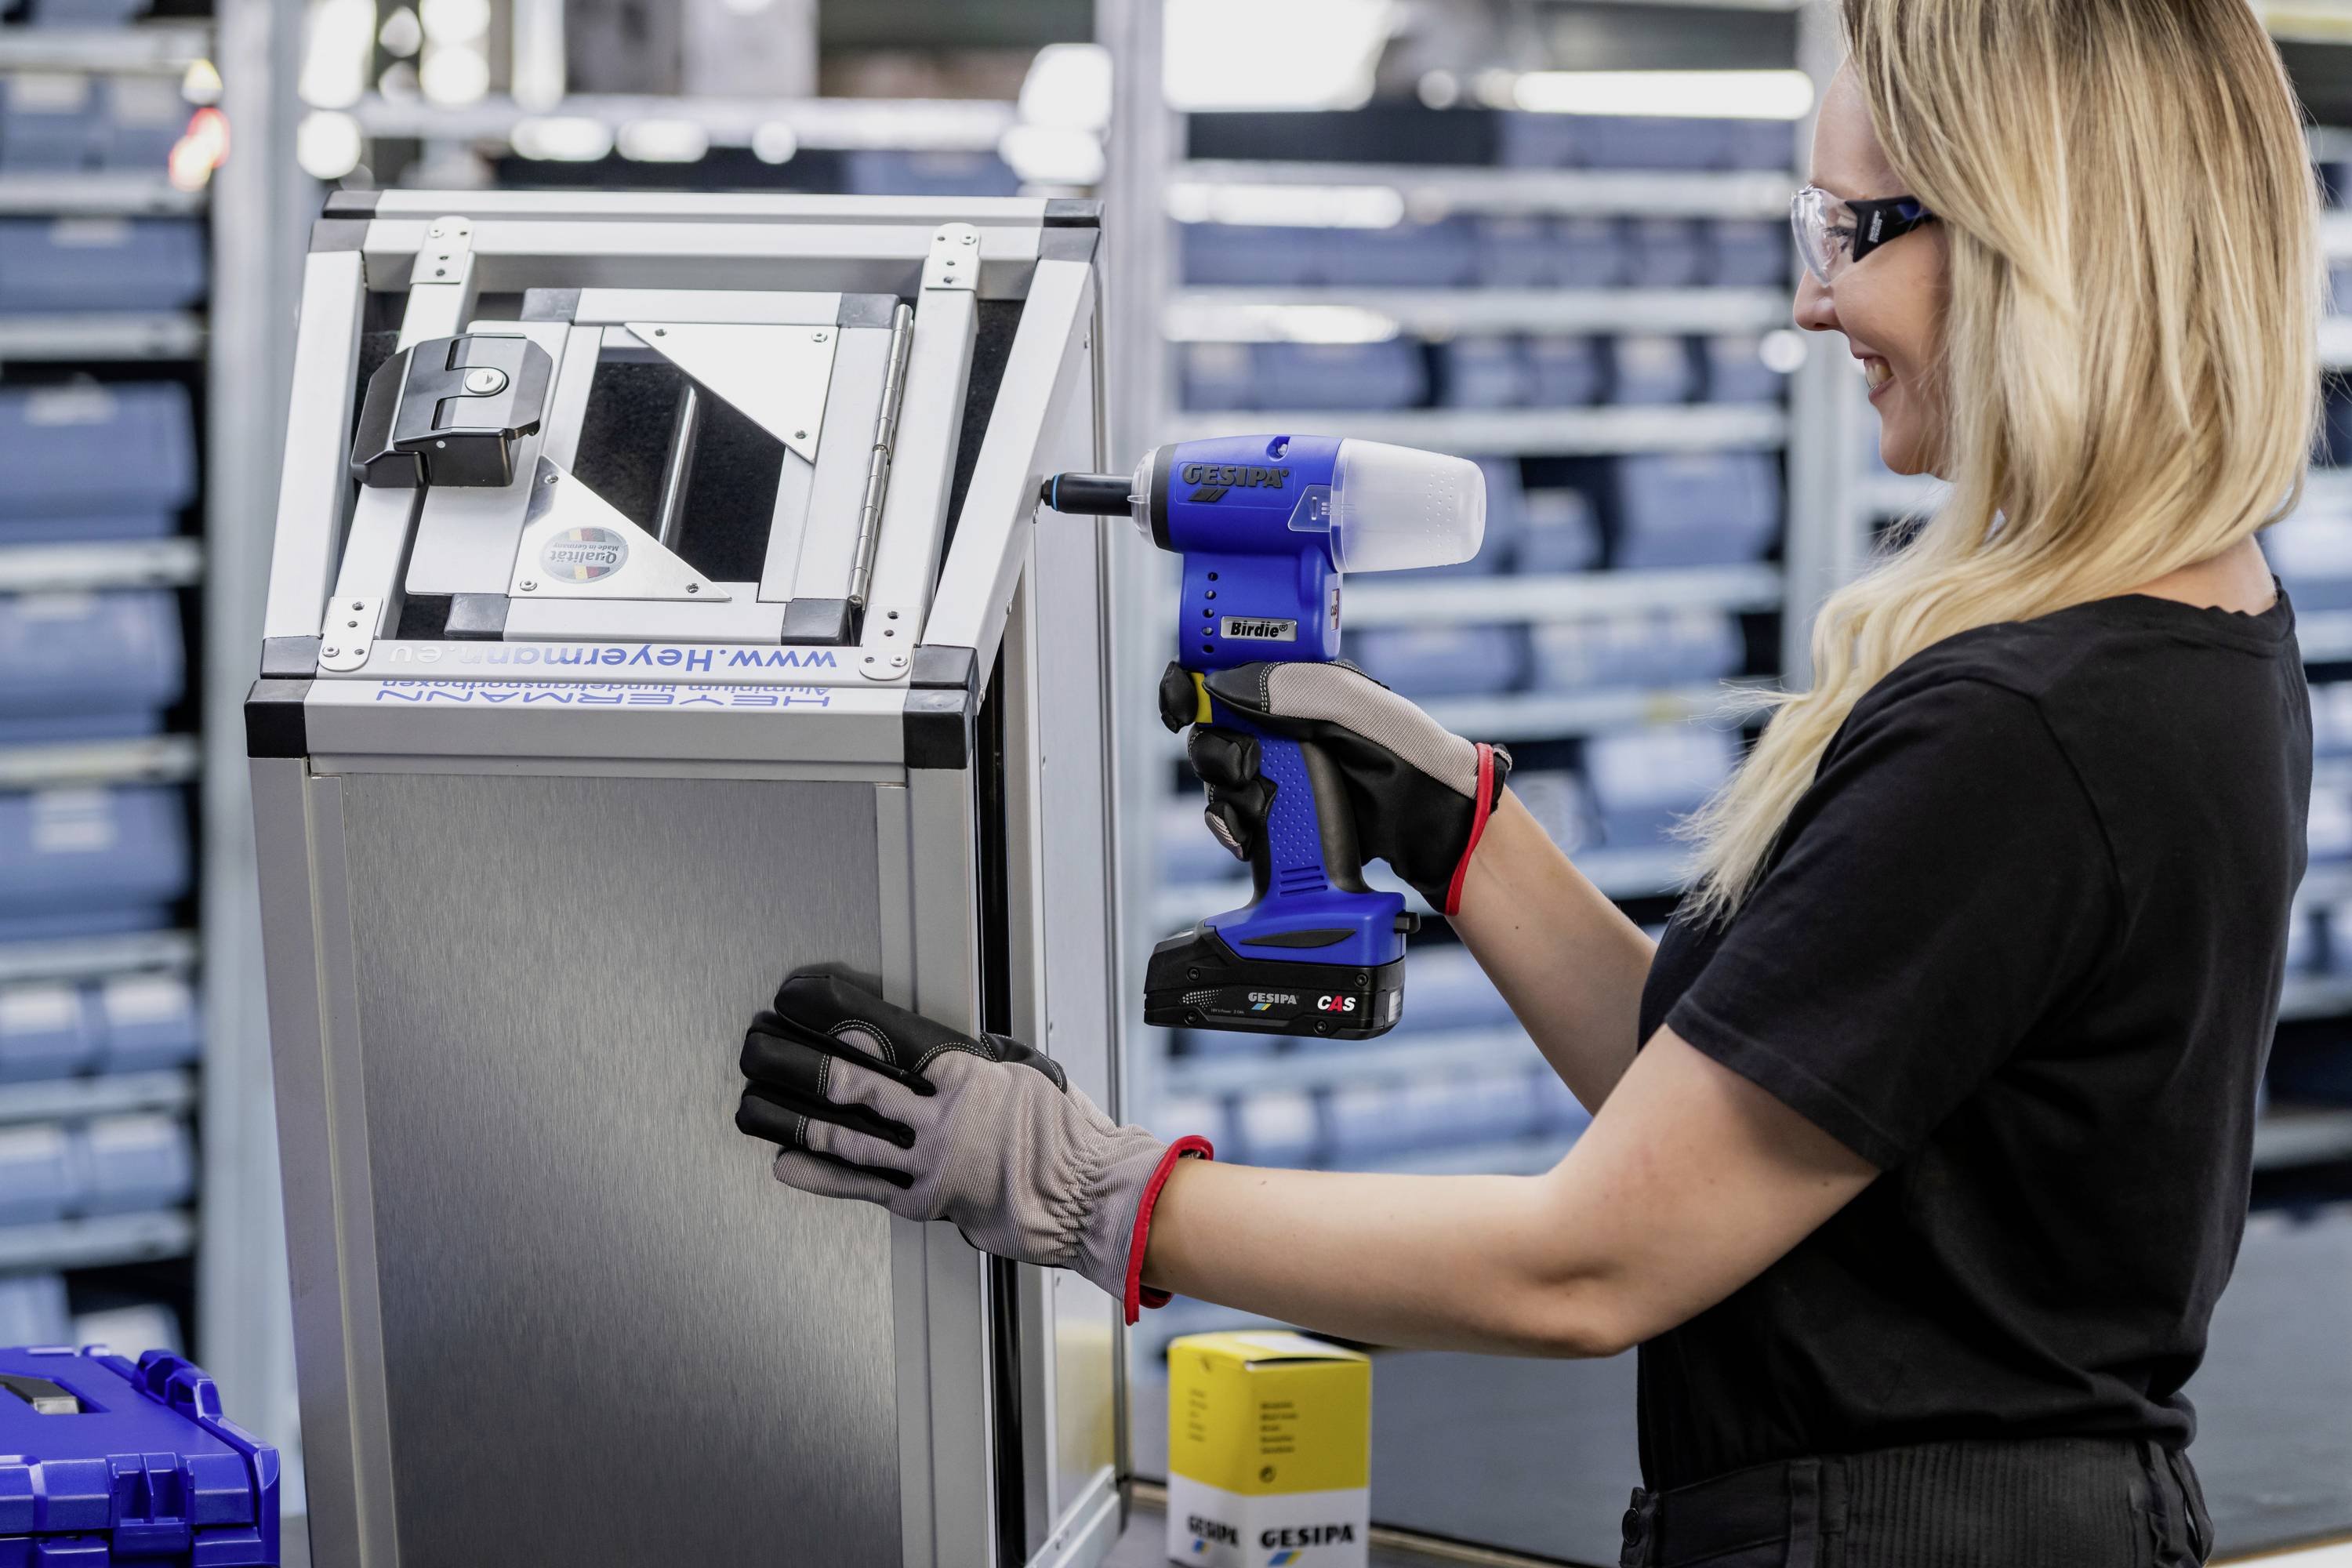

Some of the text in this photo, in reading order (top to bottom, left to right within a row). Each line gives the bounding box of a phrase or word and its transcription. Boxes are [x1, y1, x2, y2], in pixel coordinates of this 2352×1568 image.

[550, 551, 617, 564] Qualität
[389, 644, 837, 672] www.Heyermann.eu
[376, 690, 830, 707] HEYERMANN
[1248, 992, 1297, 1005] GESIPA
[1317, 994, 1356, 1012] CAS
[1260, 1523, 1355, 1549] GESIPA
